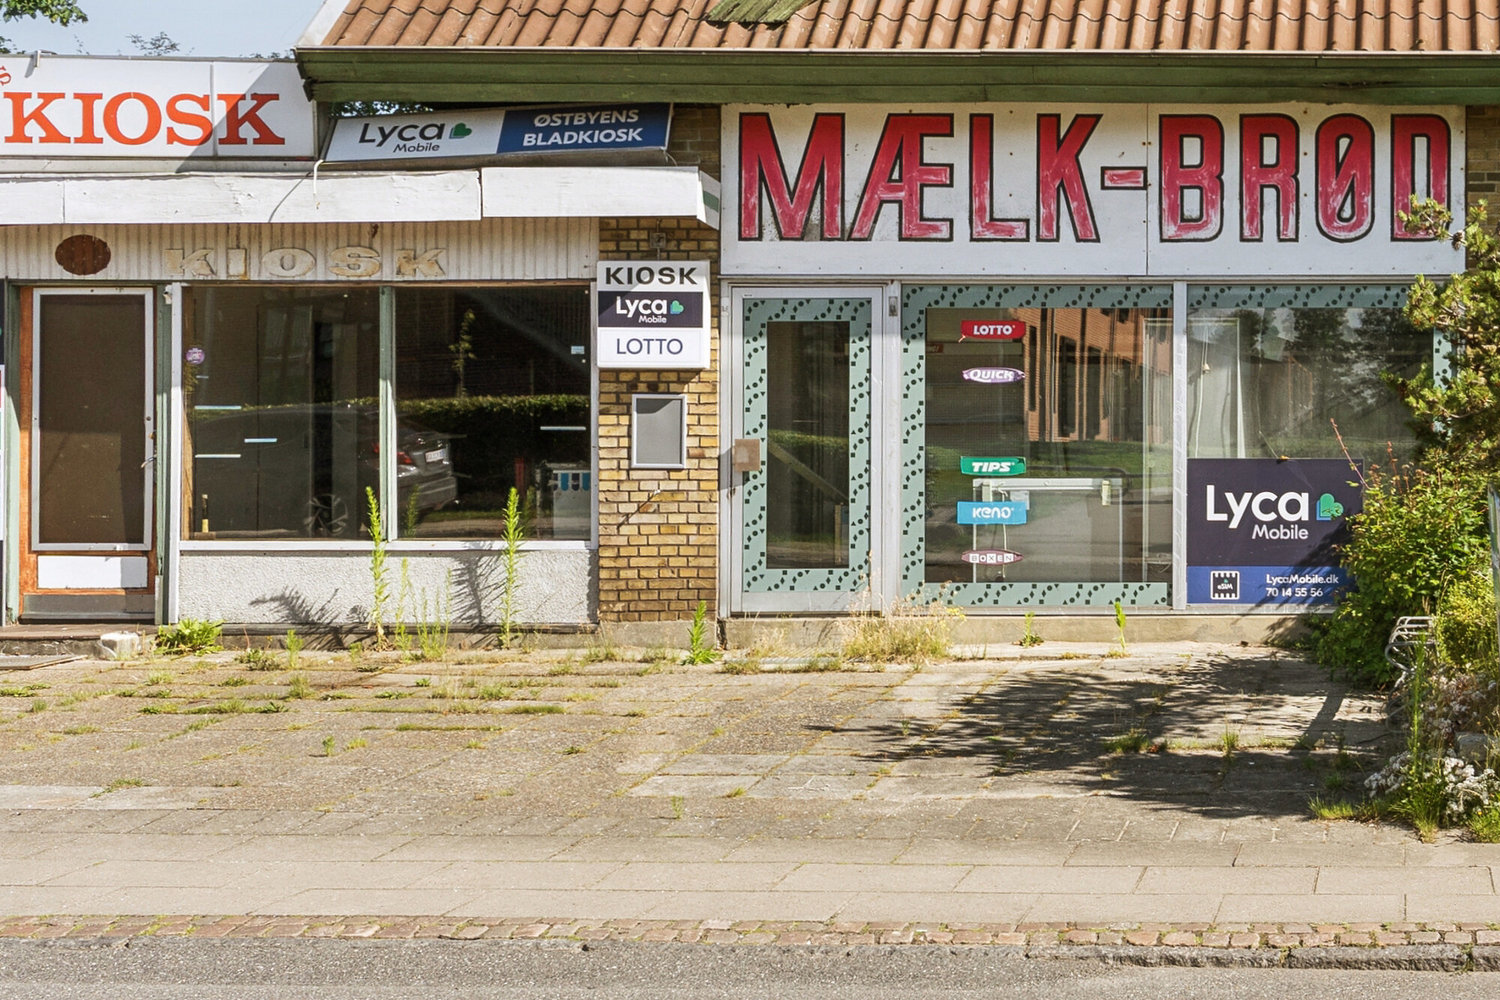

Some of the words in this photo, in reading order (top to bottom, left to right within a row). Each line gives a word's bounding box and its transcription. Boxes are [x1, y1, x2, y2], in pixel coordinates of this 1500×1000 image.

[3, 91, 286, 146] KIOSK
[533, 109, 640, 128] ØSTBYENS
[358, 122, 446, 148] Lyca
[522, 127, 643, 147] BLADKIOSK
[392, 142, 440, 153] Mobile
[737, 112, 1453, 243] MÆLK-BRØD
[164, 246, 448, 279] KIOSK
[605, 266, 698, 285] KIOSK
[616, 296, 668, 318] Lyca
[638, 315, 667, 324] Mobile
[973, 325, 1013, 335] LOTTO
[616, 338, 683, 355] LOTTO
[969, 369, 1015, 382] QUICK
[972, 462, 1012, 473] TIPS
[1206, 484, 1309, 529] Lyca
[1251, 524, 1309, 540] Mobile
[969, 553, 1014, 564] BOXEN
[1265, 574, 1339, 586] LycaMobile.dk
[1265, 588, 1279, 597] 70
[1281, 588, 1292, 597] 14
[1294, 588, 1308, 597] 55
[1310, 588, 1324, 597] 56
